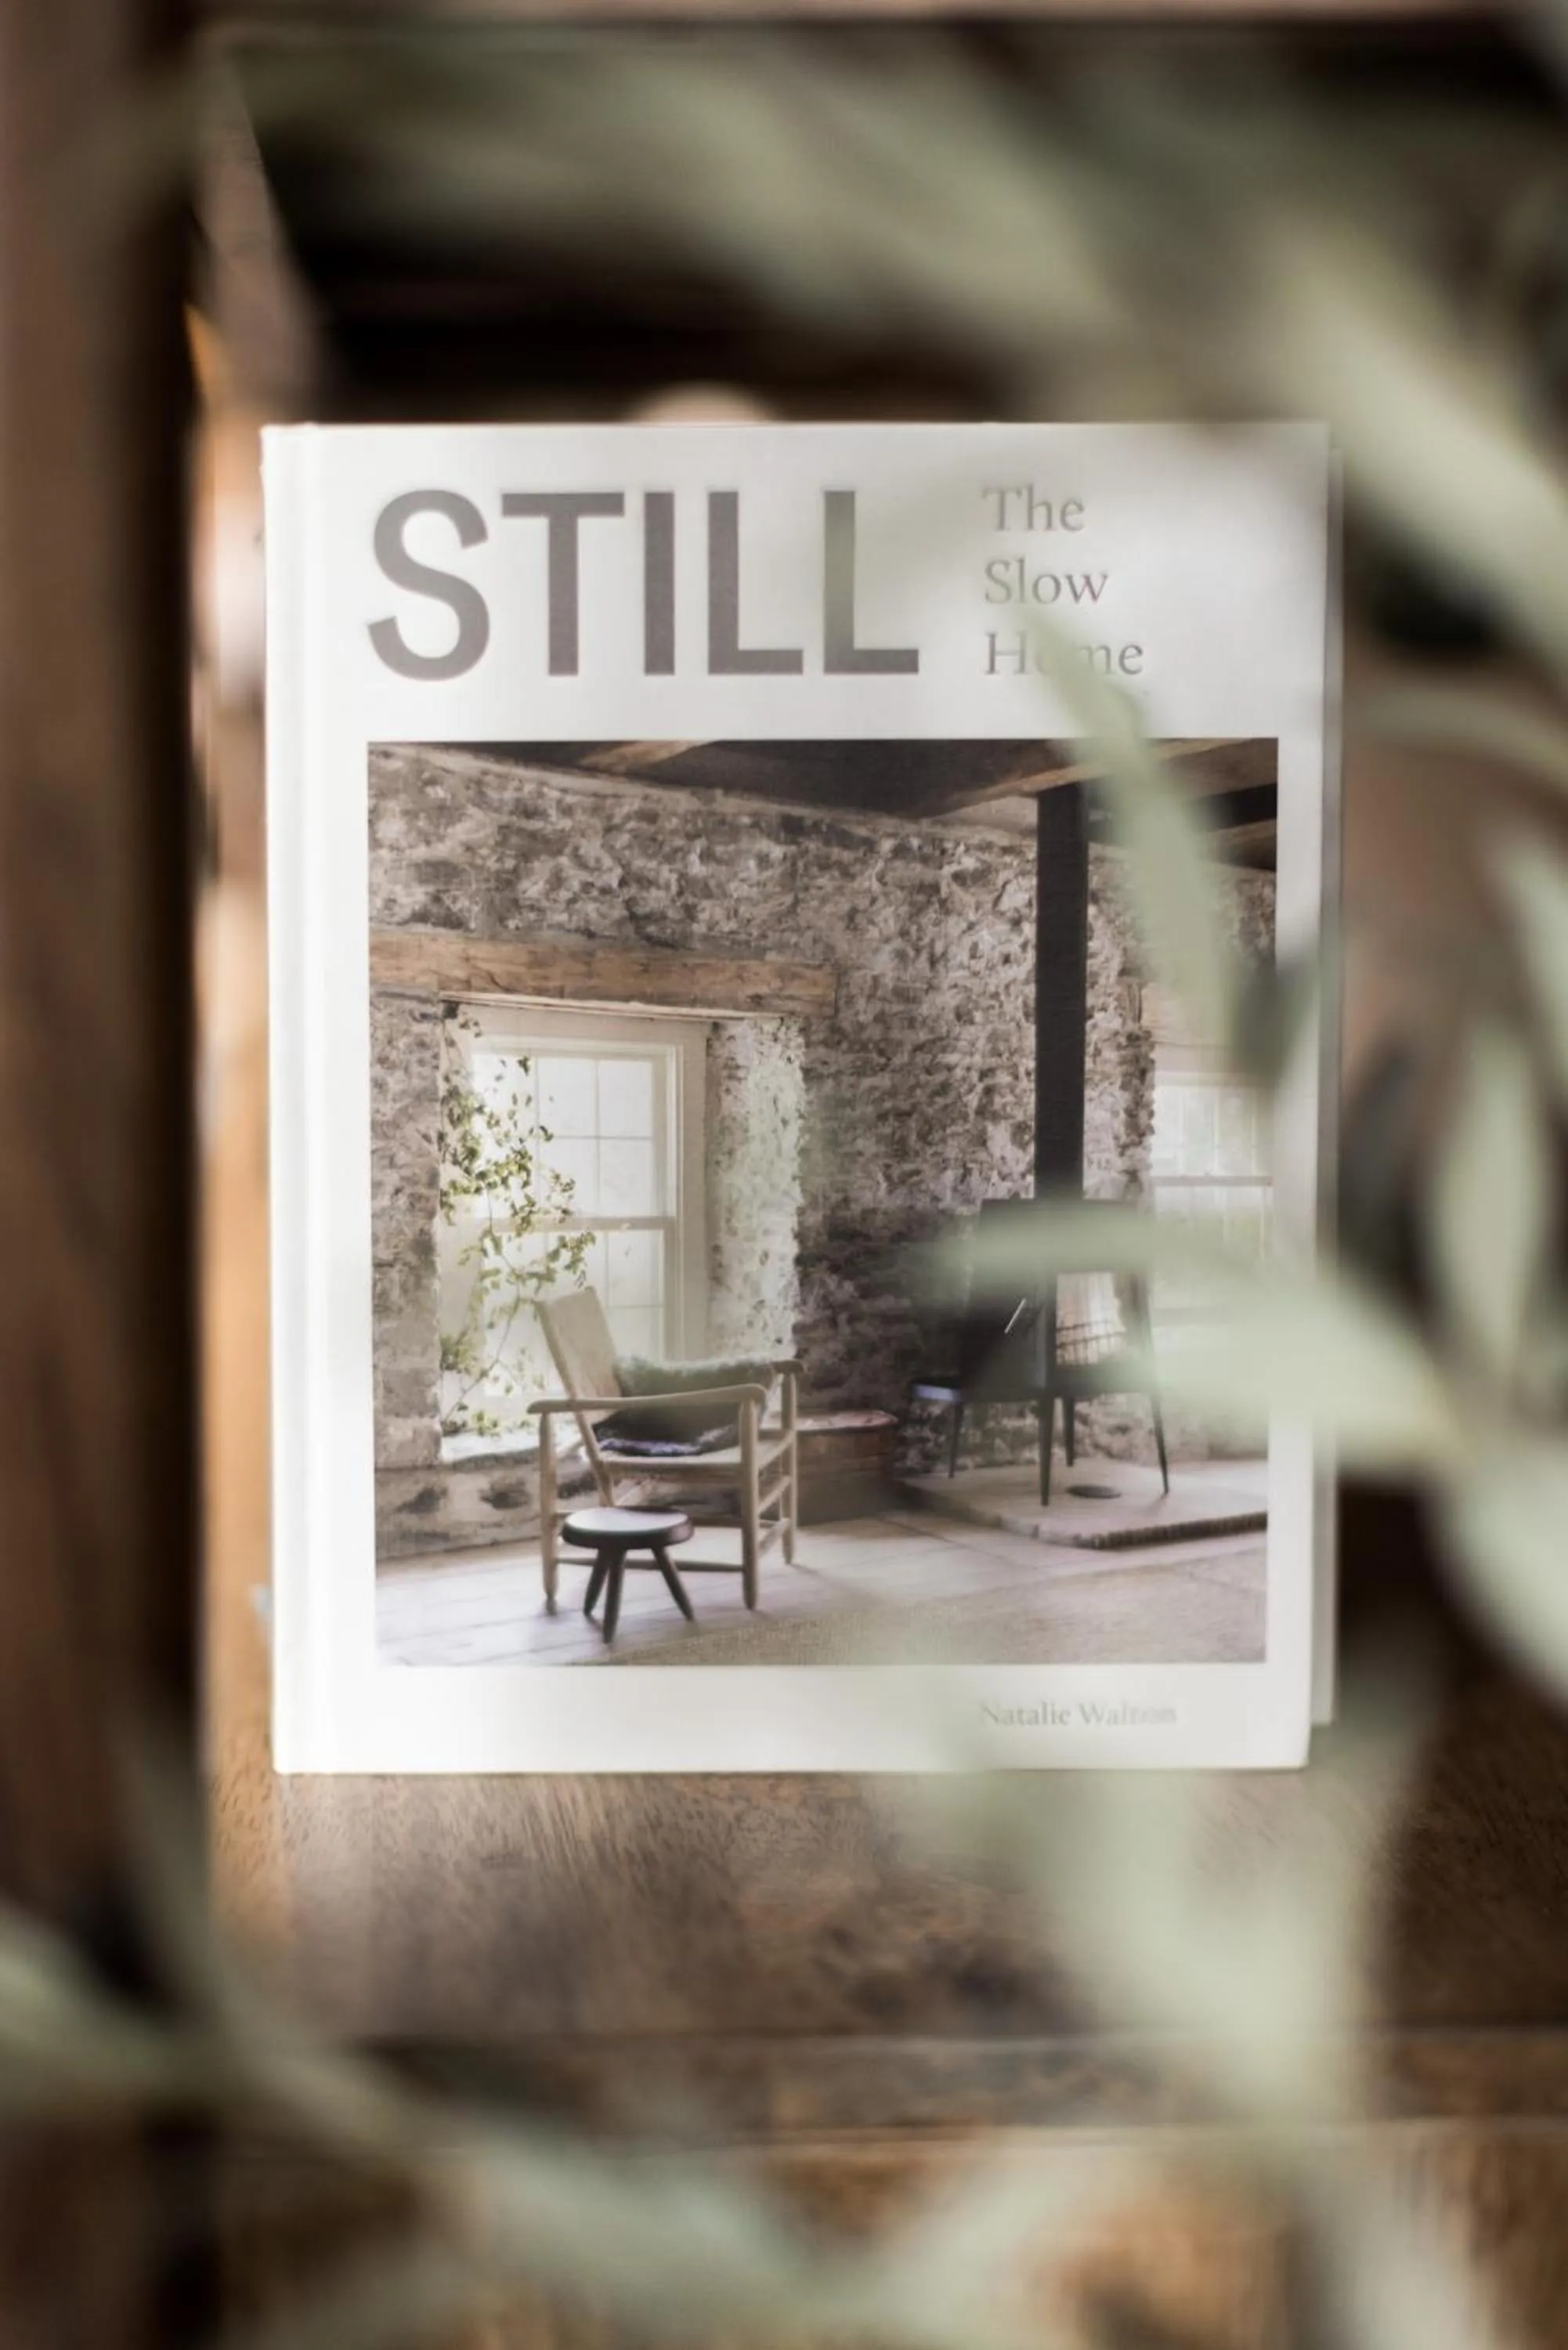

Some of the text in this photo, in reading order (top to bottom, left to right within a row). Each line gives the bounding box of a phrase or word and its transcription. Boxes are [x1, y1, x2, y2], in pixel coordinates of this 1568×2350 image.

[981, 483, 1086, 533] The
[369, 488, 919, 679] STILL
[984, 555, 1110, 606] Slow
[979, 1698, 1071, 1726] Natalie
